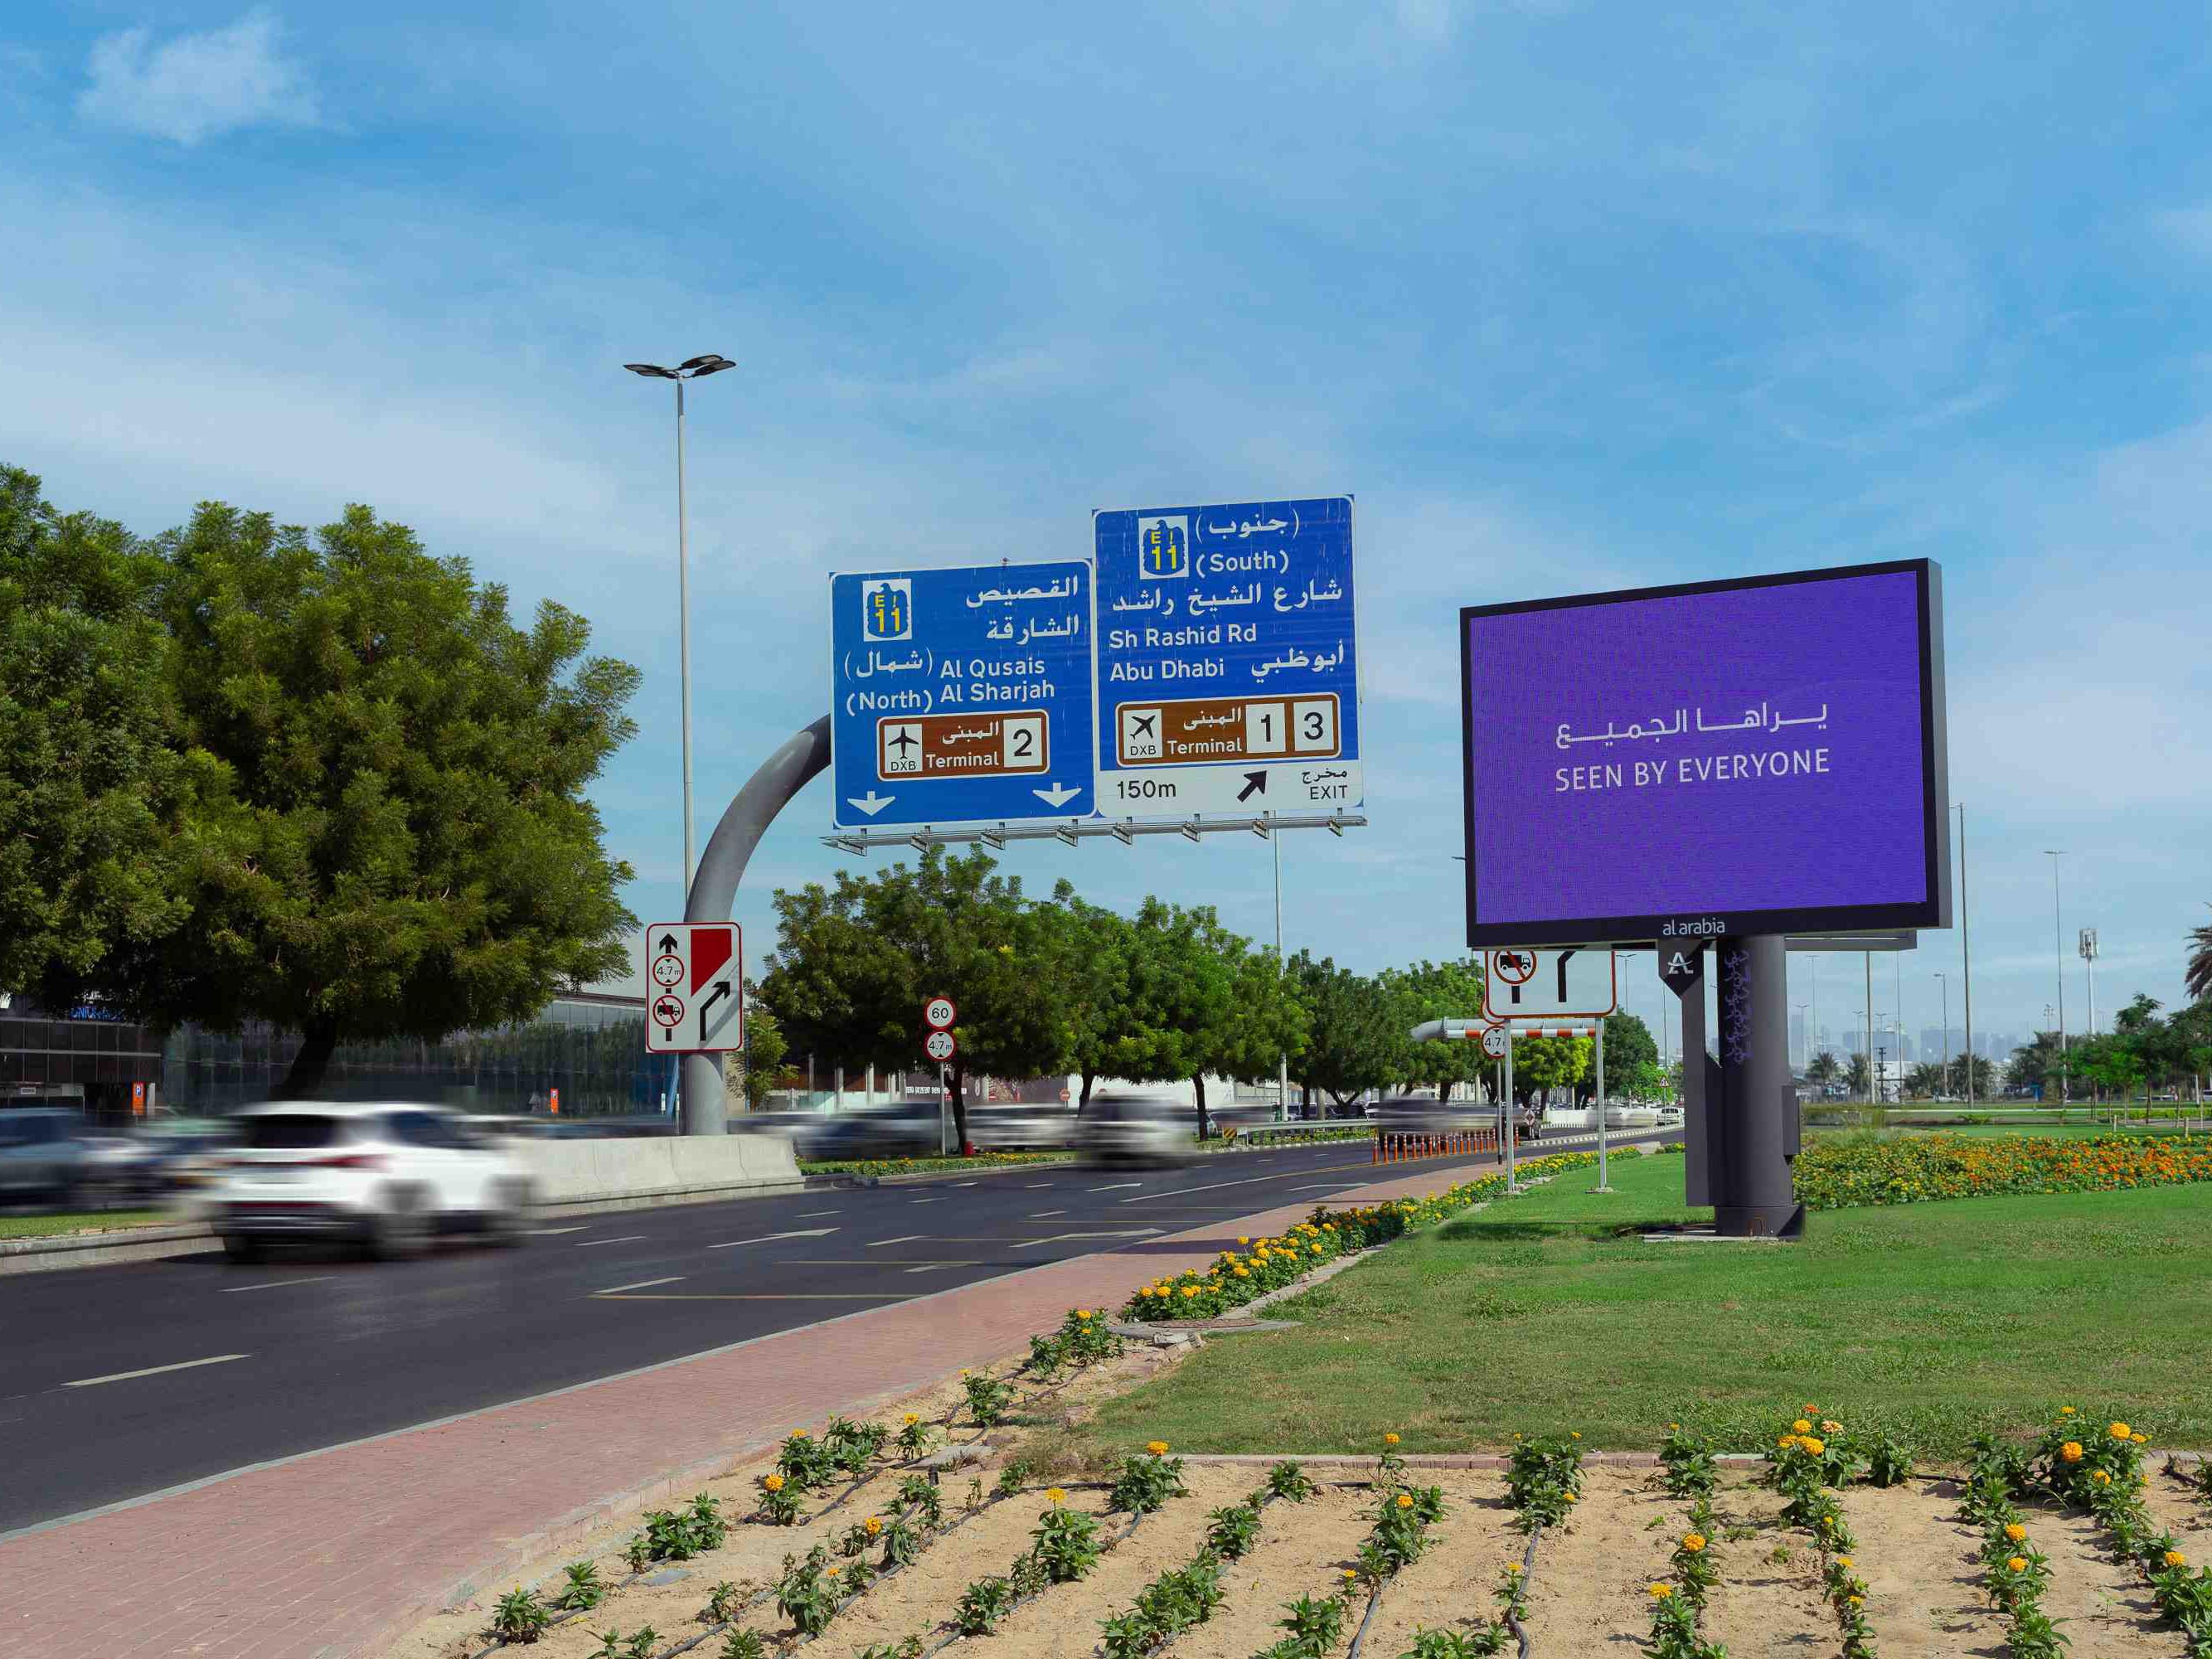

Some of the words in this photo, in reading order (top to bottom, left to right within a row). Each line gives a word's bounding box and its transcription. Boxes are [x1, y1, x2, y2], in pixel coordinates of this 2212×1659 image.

[1151, 531, 1161, 544] E
[1152, 544, 1176, 570] 11
[1196, 550, 1288, 578] (South)
[875, 594, 885, 607] E
[966, 575, 1078, 608] القصيص
[1113, 587, 1175, 616] راشد
[1187, 582, 1261, 615] الشيخ
[1273, 578, 1342, 612] شارع
[875, 607, 900, 633] 11
[986, 614, 1079, 645] الشارقة
[1109, 630, 1138, 649] Sh
[1146, 624, 1220, 647] Rashid
[1228, 623, 1257, 643] Rd
[940, 659, 963, 678] Al
[969, 657, 1045, 679] Qusais
[1109, 662, 1152, 682] Abu
[1161, 658, 1224, 680] Dhabi
[846, 690, 932, 716] (North)
[940, 684, 963, 703] Al
[970, 679, 1055, 703] Sharjah
[1183, 706, 1241, 730] المبنى
[1260, 714, 1271, 743] 1
[1303, 711, 1323, 740] 3
[942, 720, 999, 745] المبنى
[1013, 729, 1032, 757] 2
[1130, 745, 1157, 756] DXB
[1167, 737, 1242, 755] Terminal
[890, 761, 916, 771] DXB
[925, 751, 999, 769] Terminal
[1555, 764, 1623, 792] SEEN
[1635, 760, 1667, 786] BY
[1679, 748, 1830, 783] EVERYONE
[1302, 767, 1347, 783] مخرج
[1117, 780, 1176, 799] 150m
[1310, 785, 1347, 800] EXIT
[1679, 917, 1725, 935] arabia
[932, 1007, 949, 1019] 60
